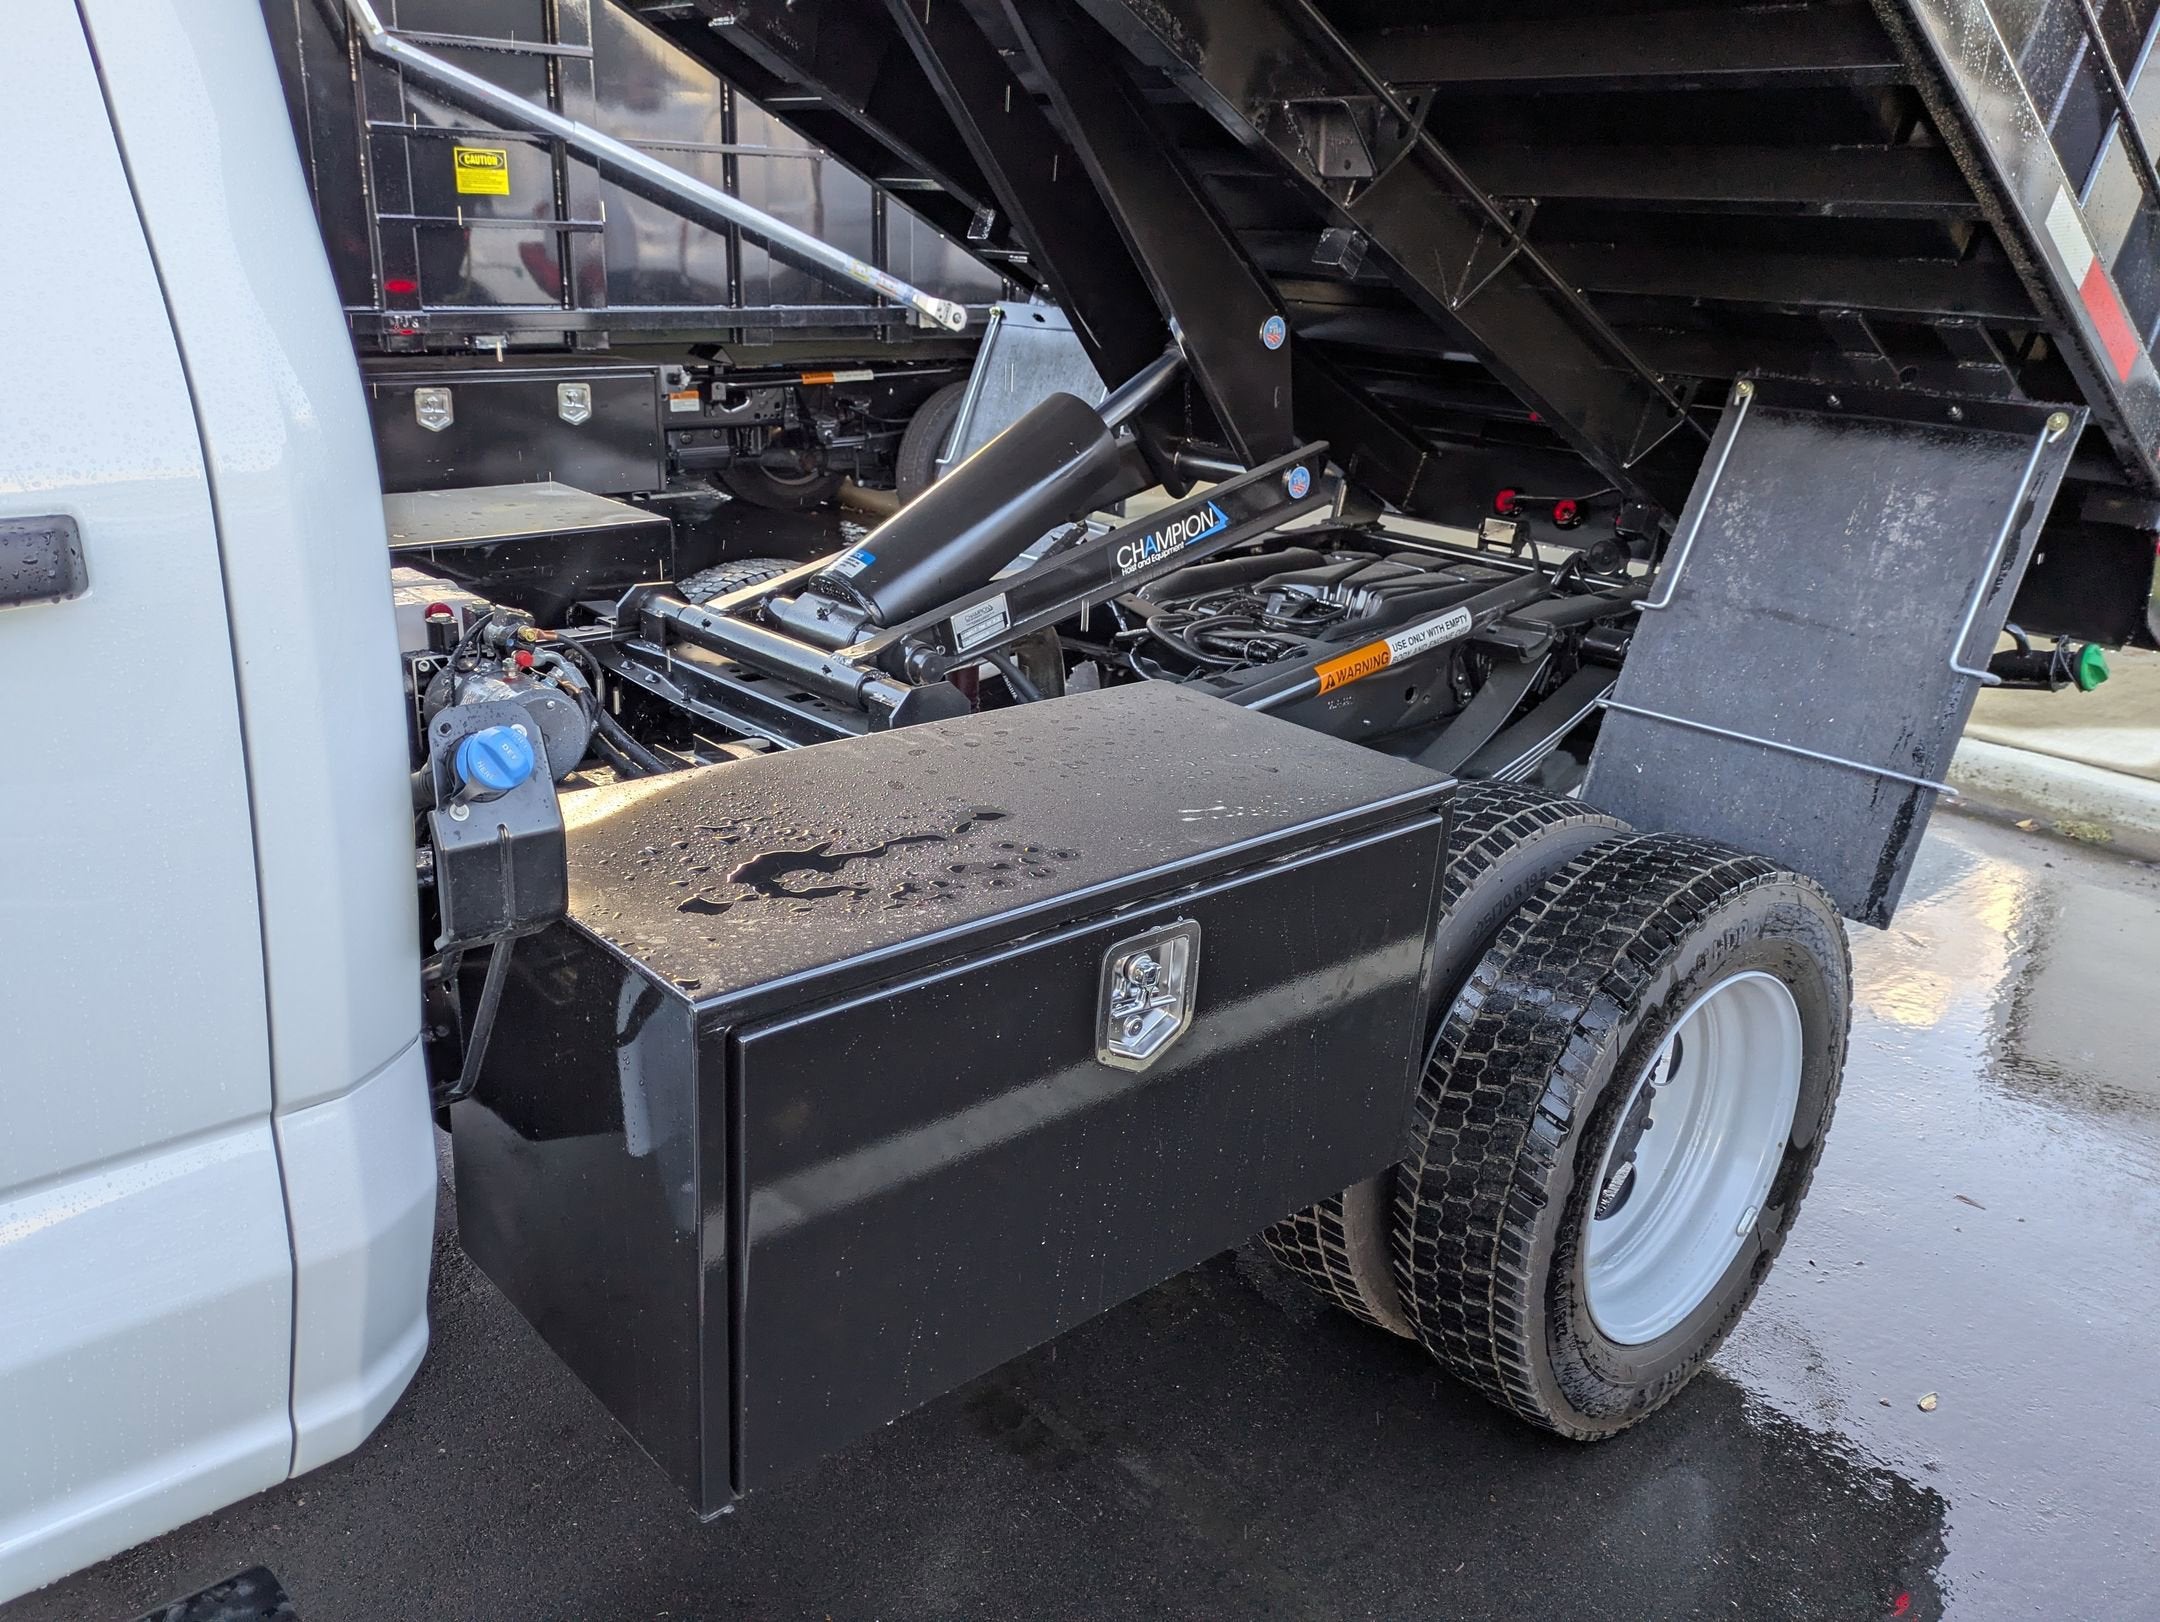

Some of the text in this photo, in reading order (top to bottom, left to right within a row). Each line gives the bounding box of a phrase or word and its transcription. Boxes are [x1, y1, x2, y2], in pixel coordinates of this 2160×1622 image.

[464, 154, 498, 166] CAUTION
[1117, 508, 1214, 568] CHAMPION
[1121, 541, 1185, 577] Hoist and Equipment
[1391, 614, 1469, 653] USE ONLY WITH EMPTY
[1336, 651, 1390, 684] WARNING
